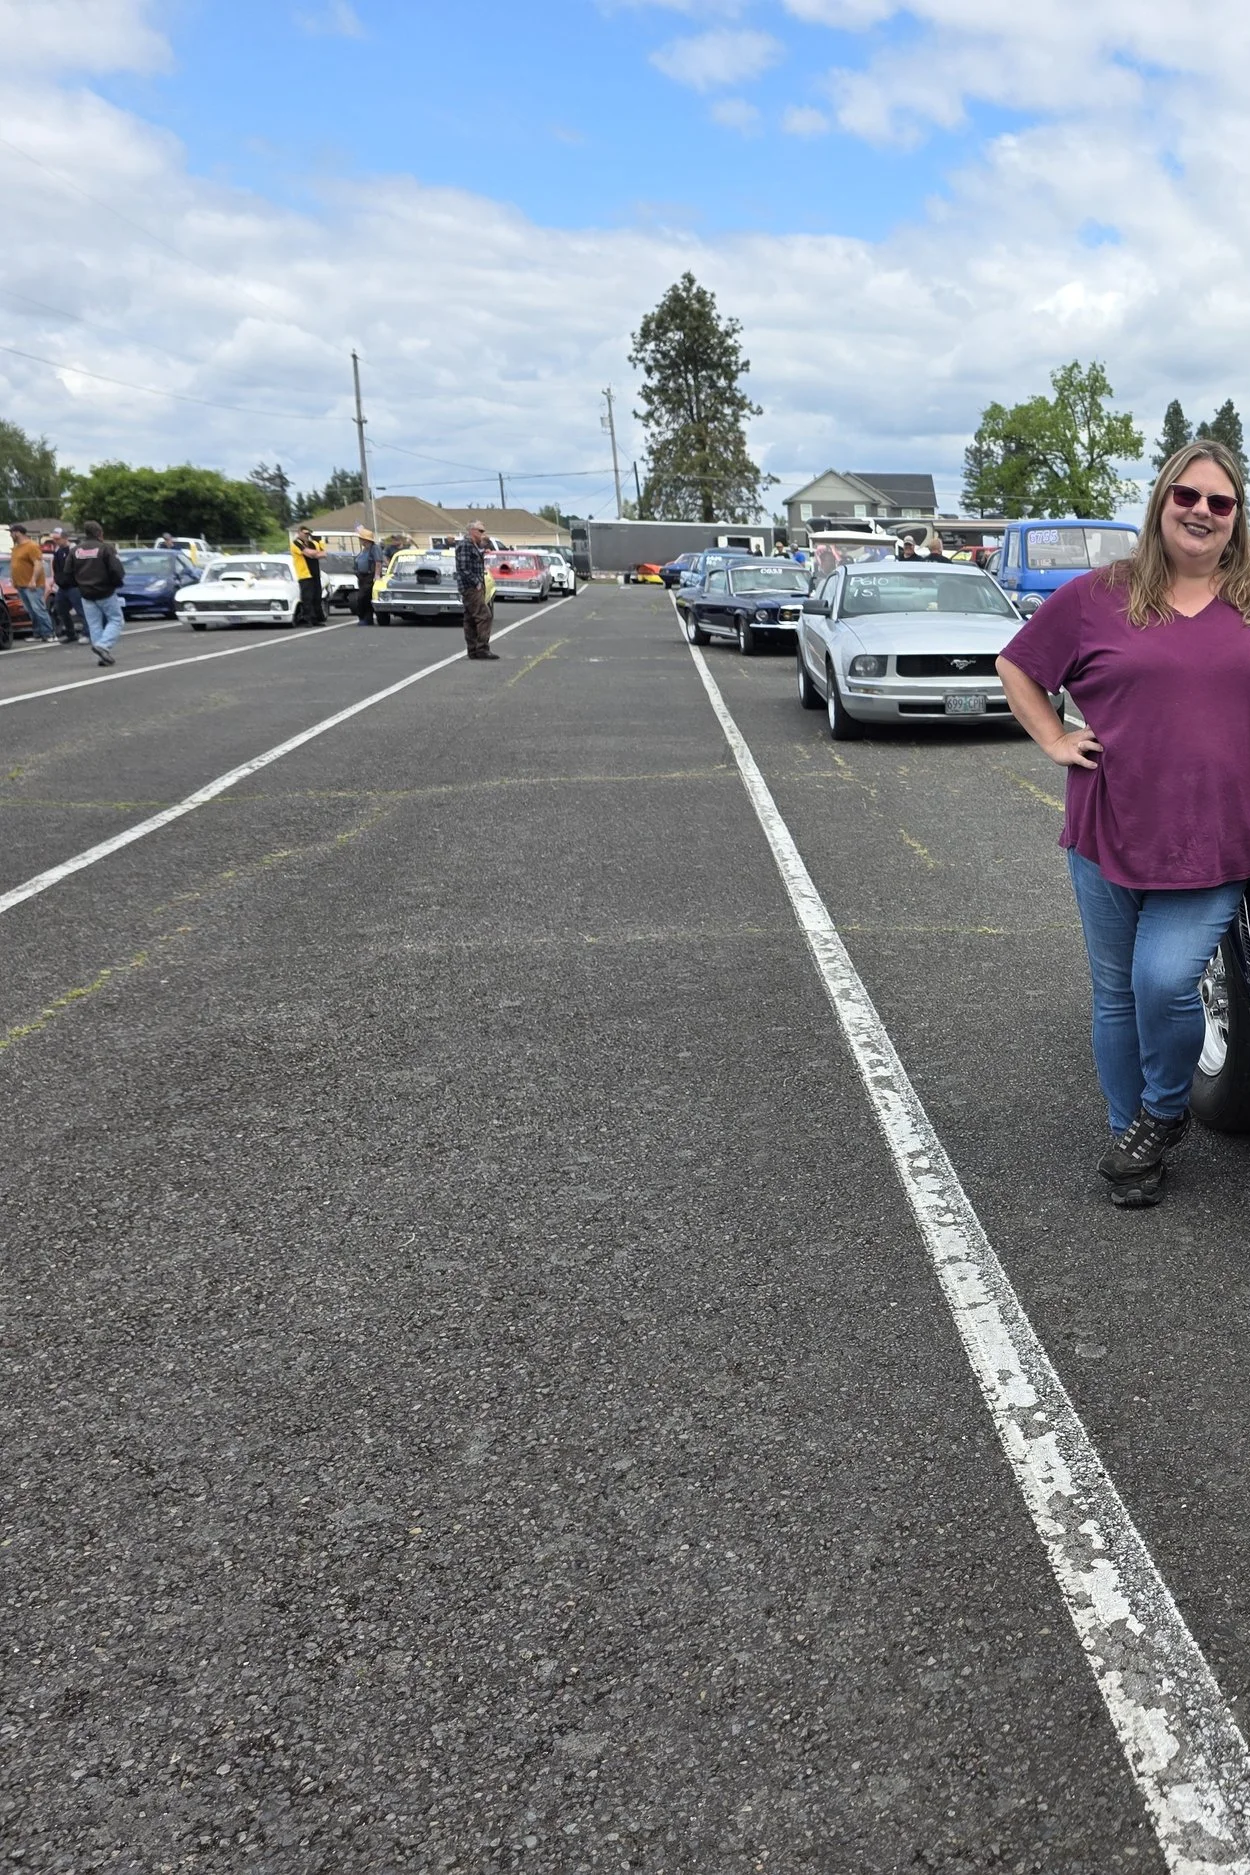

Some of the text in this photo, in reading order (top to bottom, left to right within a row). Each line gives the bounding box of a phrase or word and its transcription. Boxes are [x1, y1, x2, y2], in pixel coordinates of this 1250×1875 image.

[849, 576, 889, 586] P610
[947, 698, 984, 710] 699 CPH
